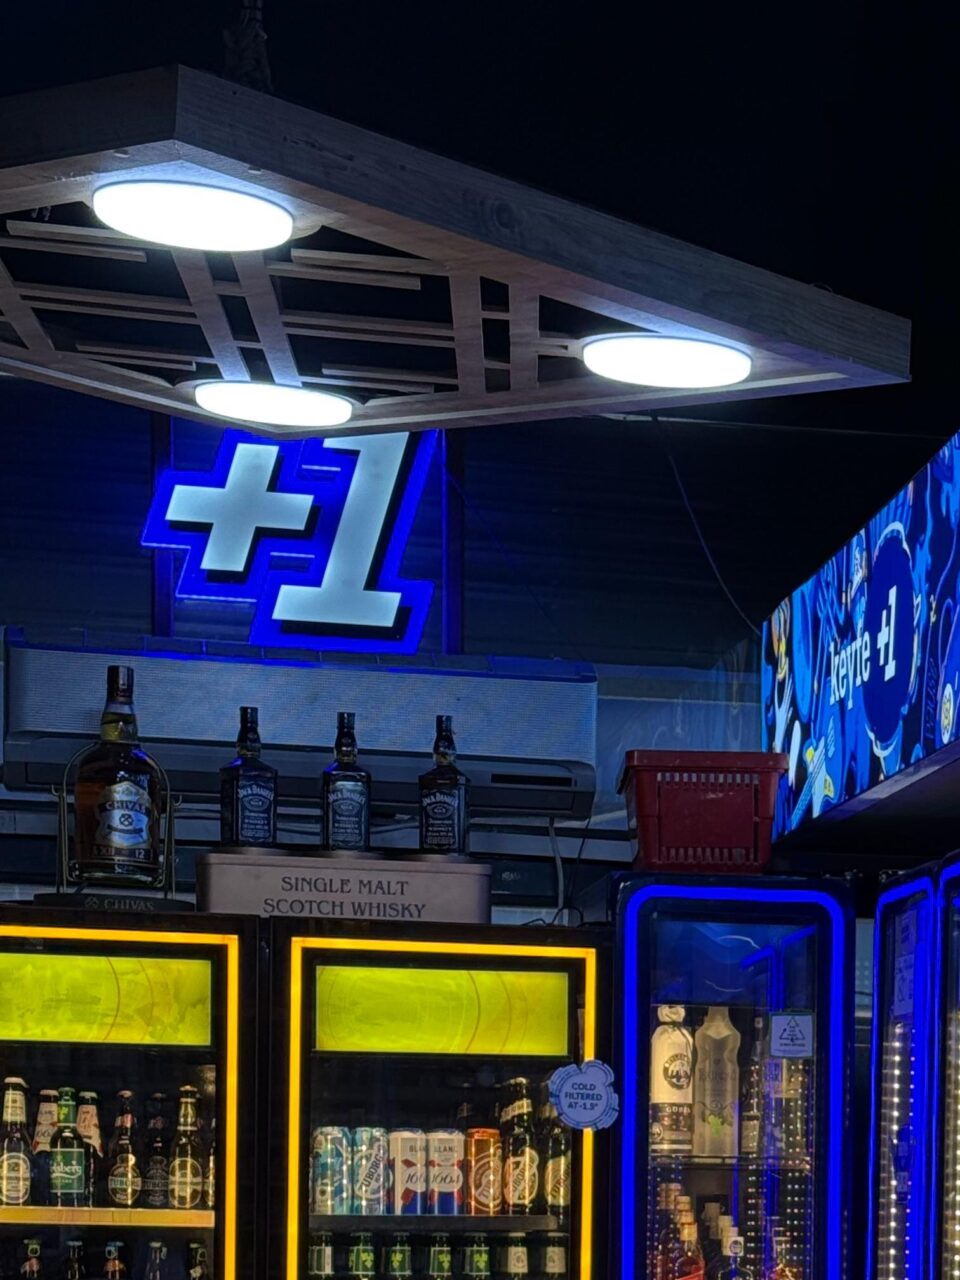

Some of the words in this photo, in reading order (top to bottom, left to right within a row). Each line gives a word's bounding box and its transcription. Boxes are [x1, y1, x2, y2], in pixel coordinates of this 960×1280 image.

[165, 431, 409, 628] +1
[829, 620, 871, 710] keyfe
[877, 585, 897, 682] +1
[105, 800, 147, 813] CHIVAS
[281, 876, 352, 894] SINGLE
[358, 879, 410, 897] MALT
[103, 899, 154, 912] CHIVAS
[263, 898, 345, 916] SCOTCH
[352, 902, 427, 919] WHISKY
[571, 1083, 596, 1091] COLD
[565, 1092, 603, 1101] FILTERED
